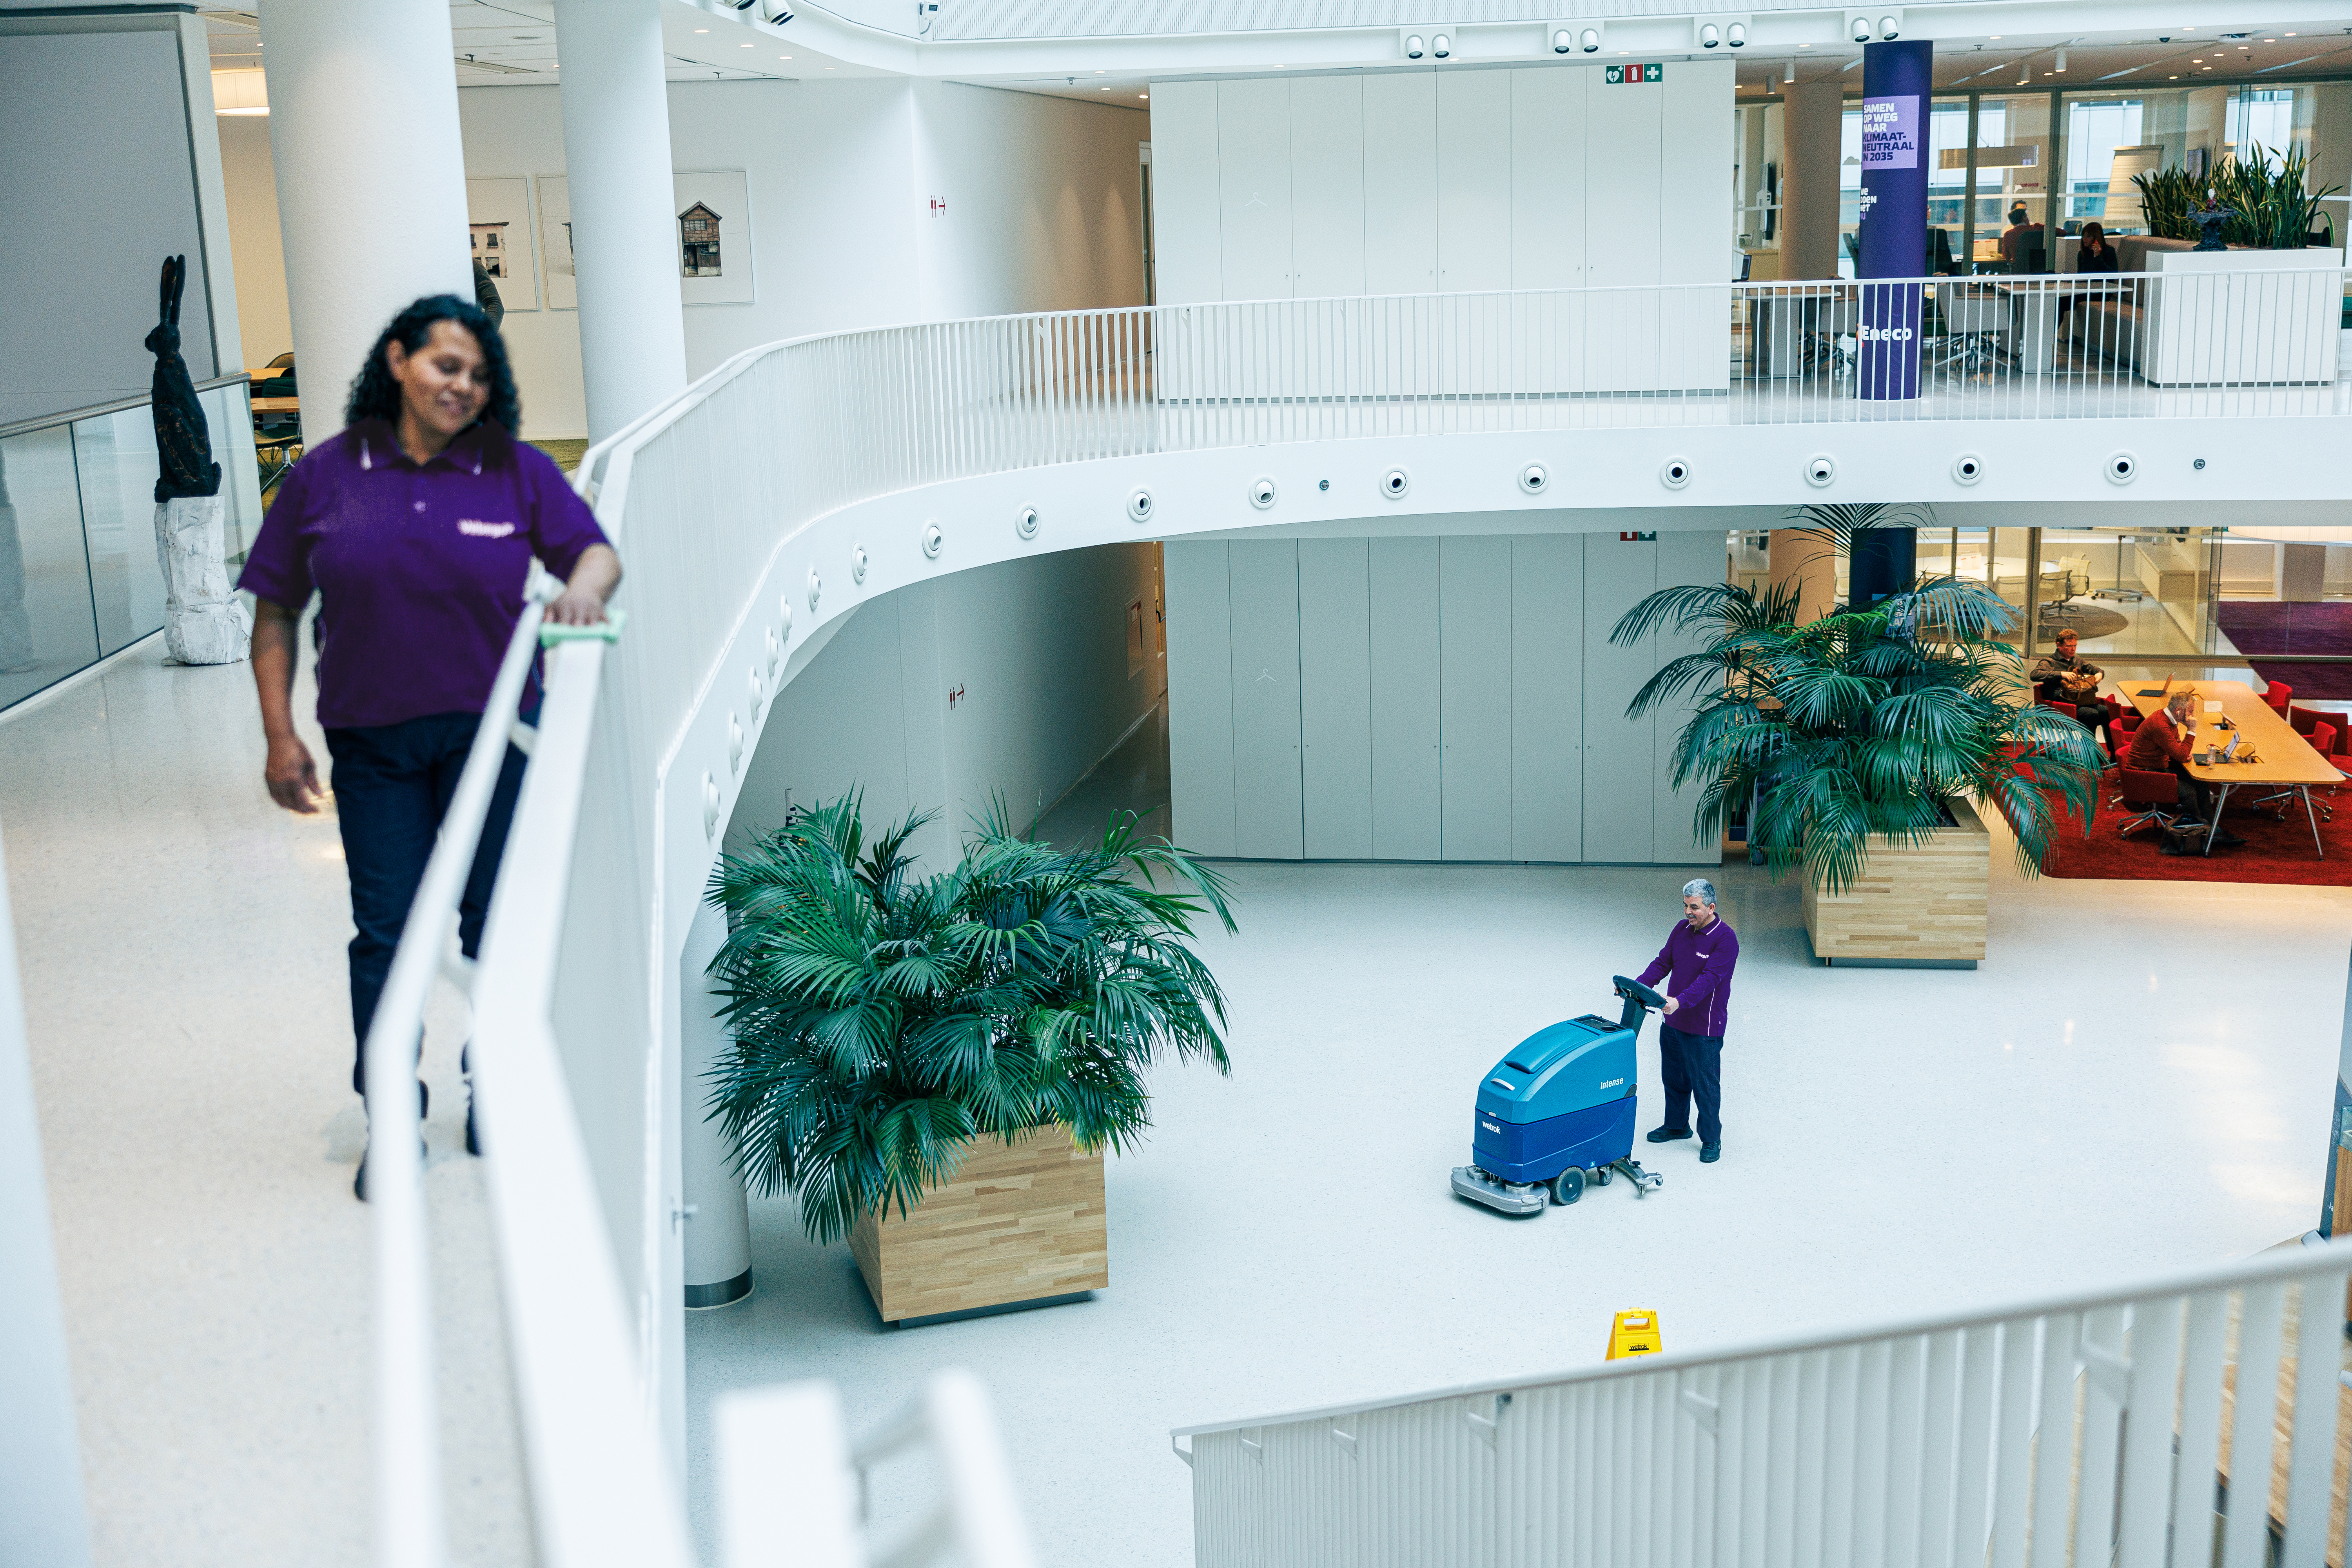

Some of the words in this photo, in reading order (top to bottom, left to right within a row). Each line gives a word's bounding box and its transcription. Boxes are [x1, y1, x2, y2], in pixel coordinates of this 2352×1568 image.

[1864, 103, 1894, 113] SAMEN
[1864, 114, 1872, 123] OP
[1873, 113, 1898, 122] WEG
[1863, 123, 1887, 133] NAAR
[1863, 132, 1906, 142] KLIMAAT-
[1863, 142, 1914, 152] NEUTRAAL
[1862, 153, 1868, 161] IN
[1870, 152, 1893, 161] 2035
[1862, 325, 1912, 341] Eneco
[1600, 1077, 1624, 1090] Intense
[1482, 1121, 1501, 1134] wetrok
